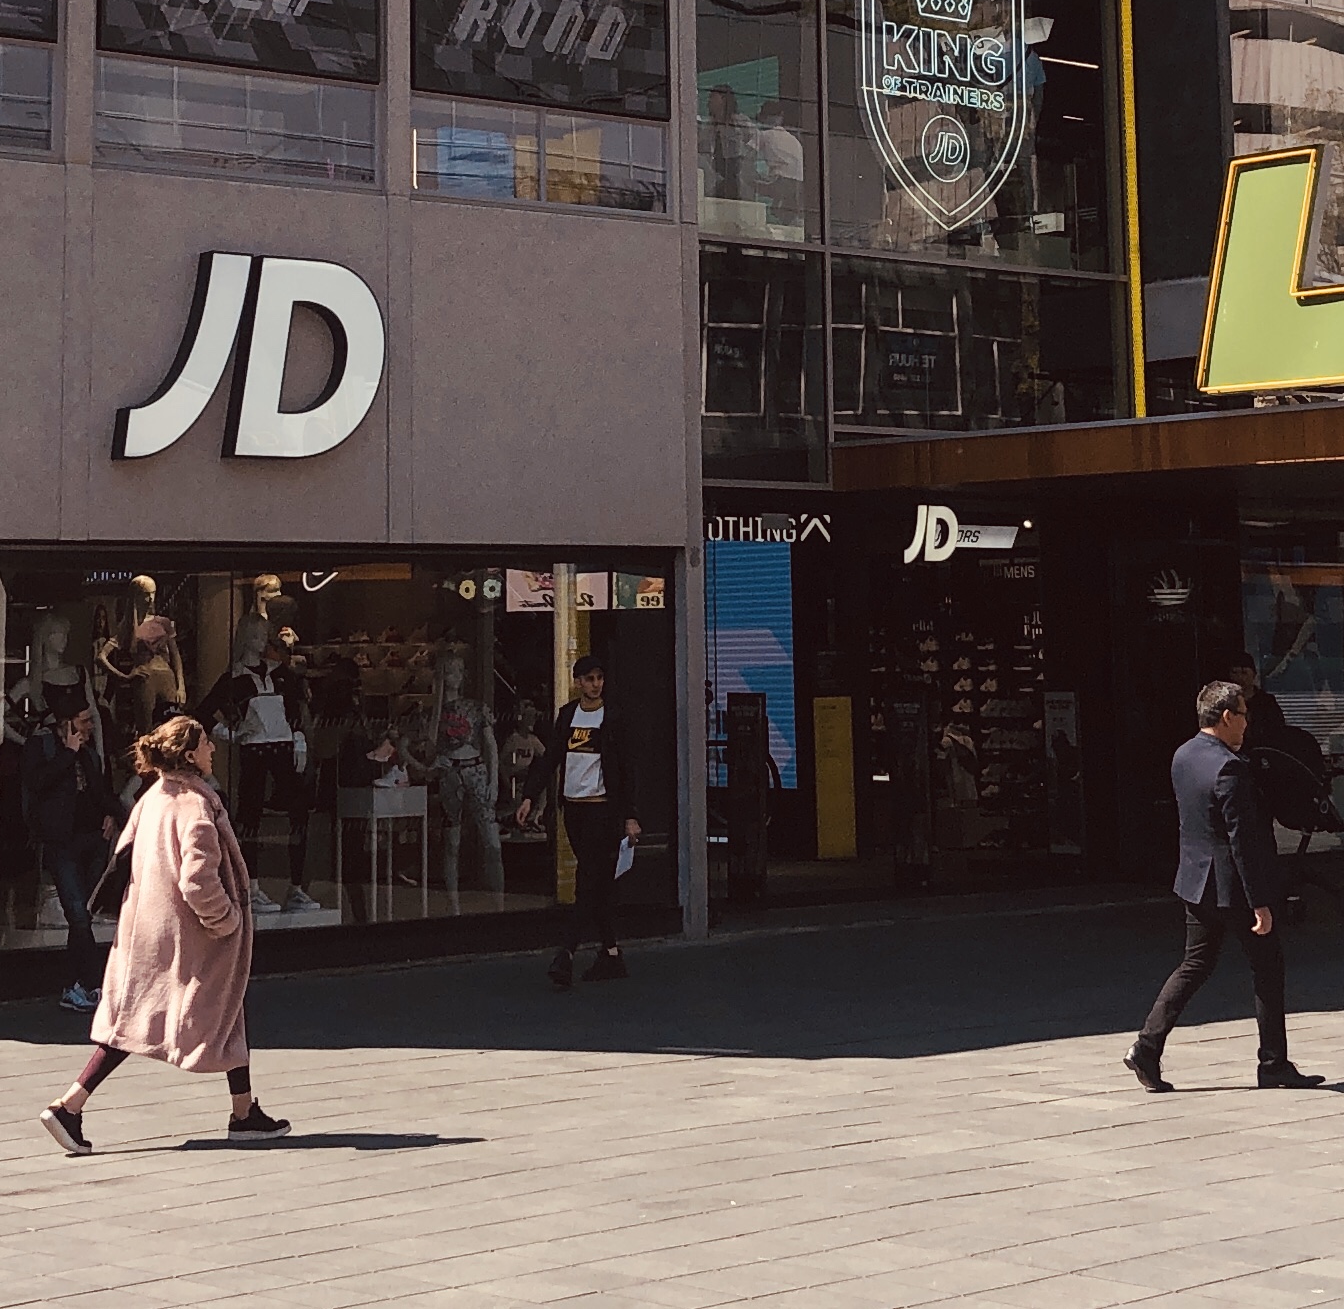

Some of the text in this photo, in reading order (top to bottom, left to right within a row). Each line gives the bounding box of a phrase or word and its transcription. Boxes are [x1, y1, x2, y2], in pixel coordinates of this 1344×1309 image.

[882, 21, 1006, 87] KING
[882, 75, 1005, 112] OF TRAINERS
[929, 131, 965, 166] JD
[113, 251, 386, 460] JD
[903, 504, 959, 564] JD
[572, 728, 592, 740] NIKE
